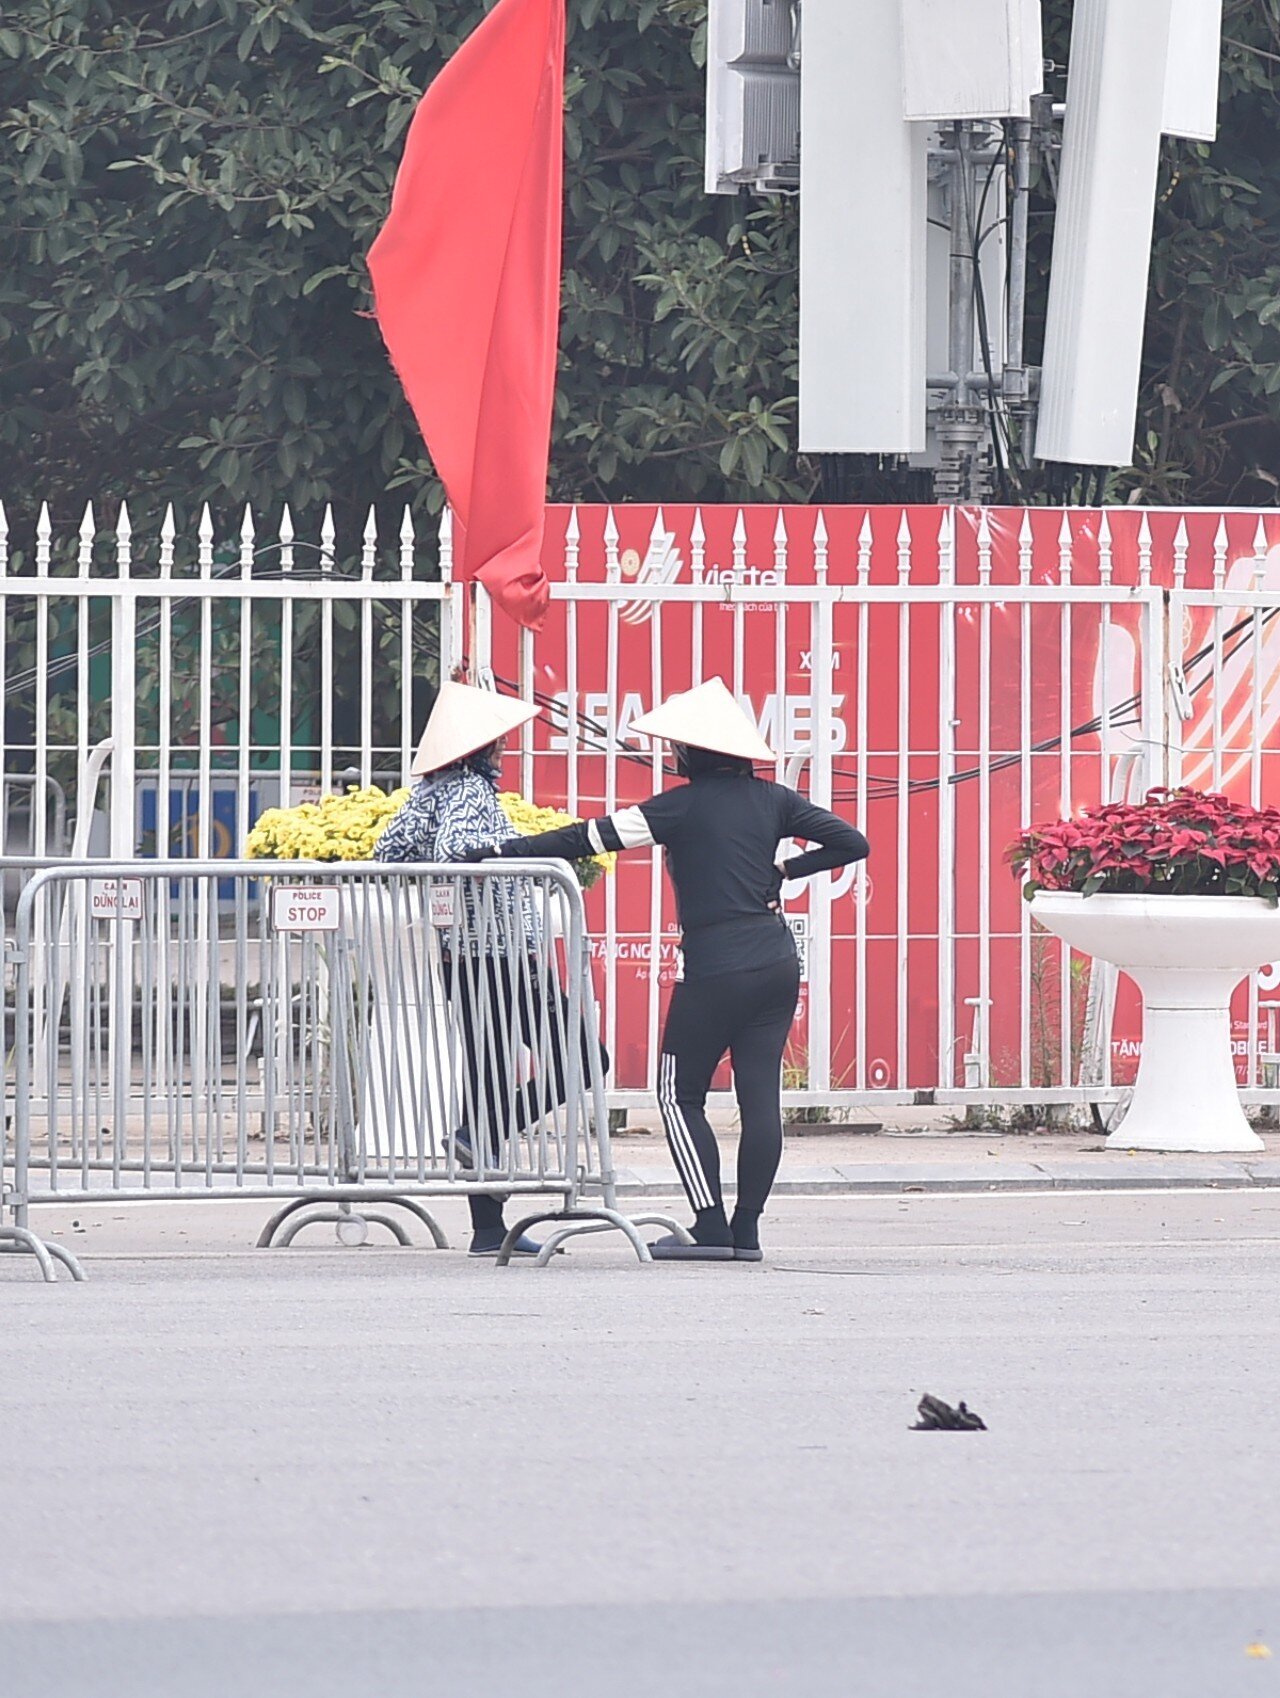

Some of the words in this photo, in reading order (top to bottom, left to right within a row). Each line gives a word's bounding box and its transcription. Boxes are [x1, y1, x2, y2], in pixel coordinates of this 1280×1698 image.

[799, 651, 841, 670] XM
[550, 691, 646, 751] SEA
[292, 891, 322, 900] POLICE
[287, 907, 327, 922] STOP
[630, 943, 671, 959] NGY
